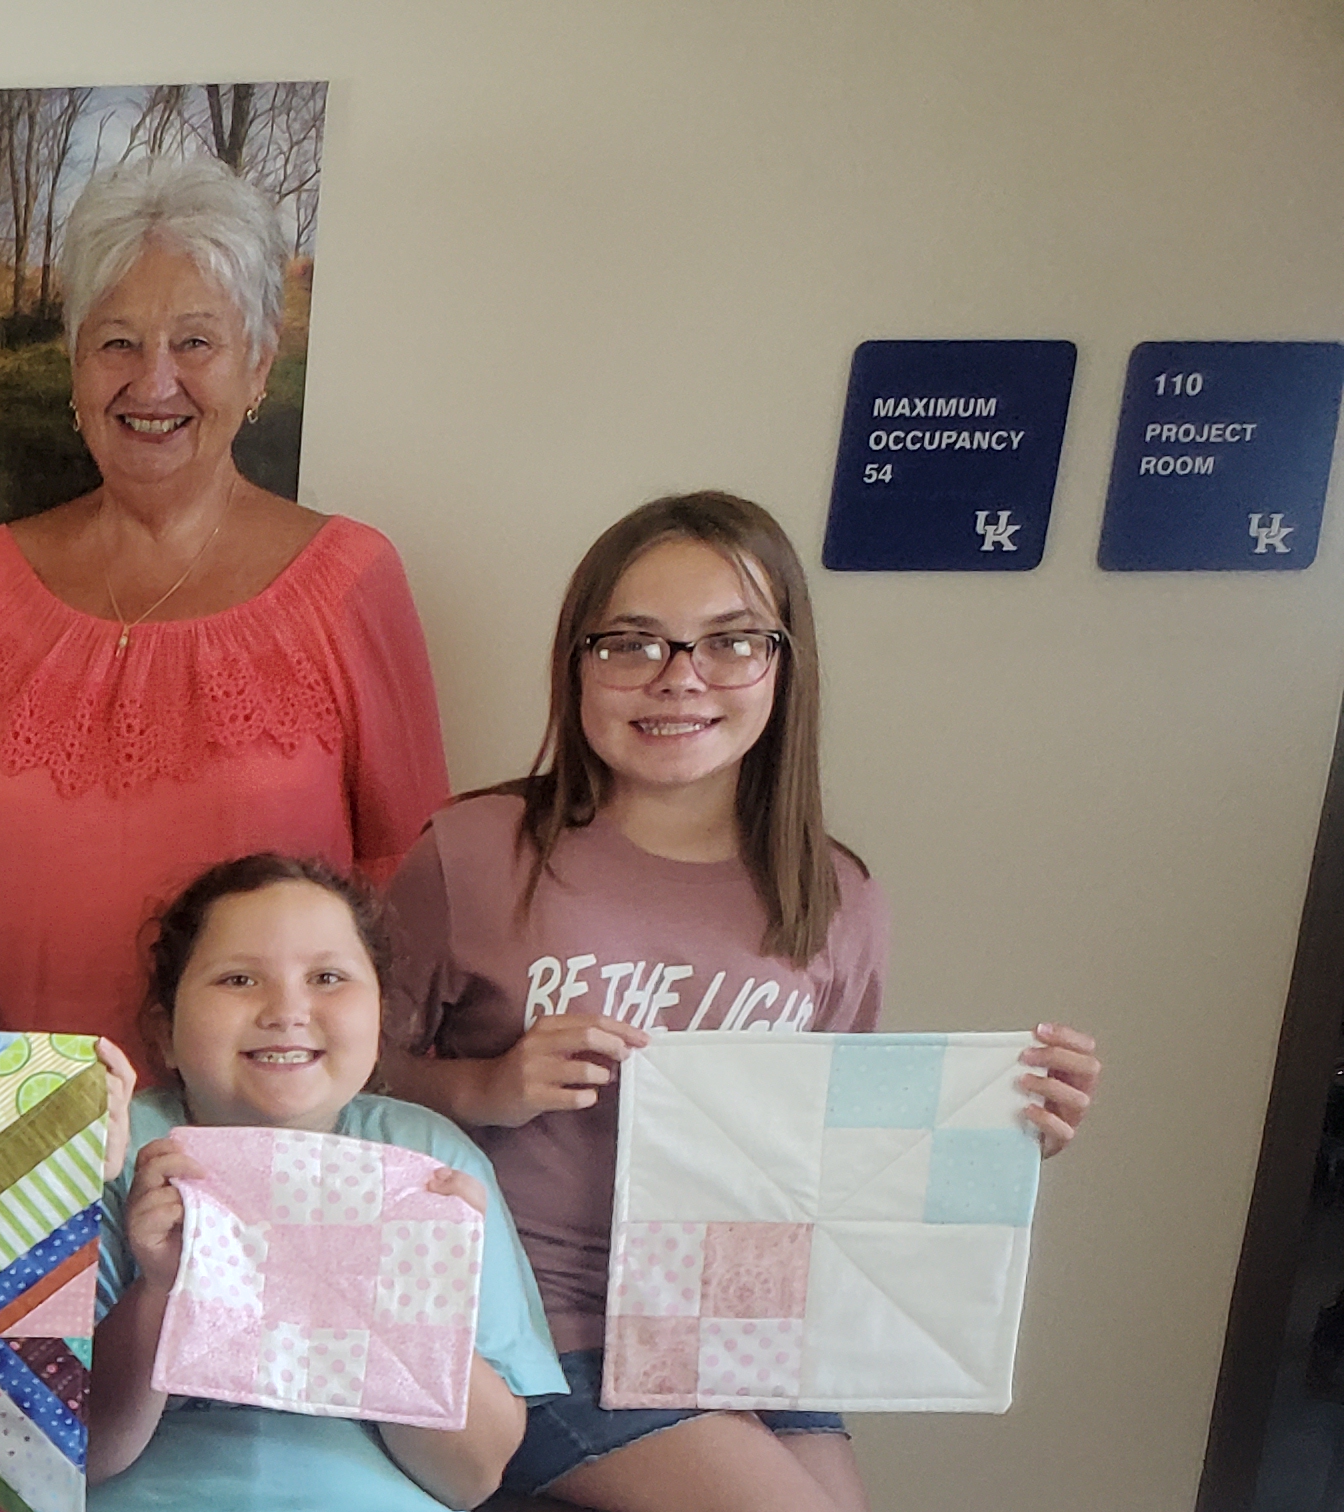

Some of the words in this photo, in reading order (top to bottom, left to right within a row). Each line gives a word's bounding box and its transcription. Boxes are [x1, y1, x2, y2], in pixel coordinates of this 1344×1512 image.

[1154, 372, 1203, 396] 110
[872, 397, 998, 418] MAXIMUM
[869, 430, 1025, 450] OCCUPANCY
[1144, 423, 1258, 443] PROJECT
[862, 463, 894, 484] 54
[1139, 456, 1215, 475] ROOM
[975, 510, 1021, 552] UK
[1249, 513, 1294, 554] UK
[601, 961, 693, 1032] THE
